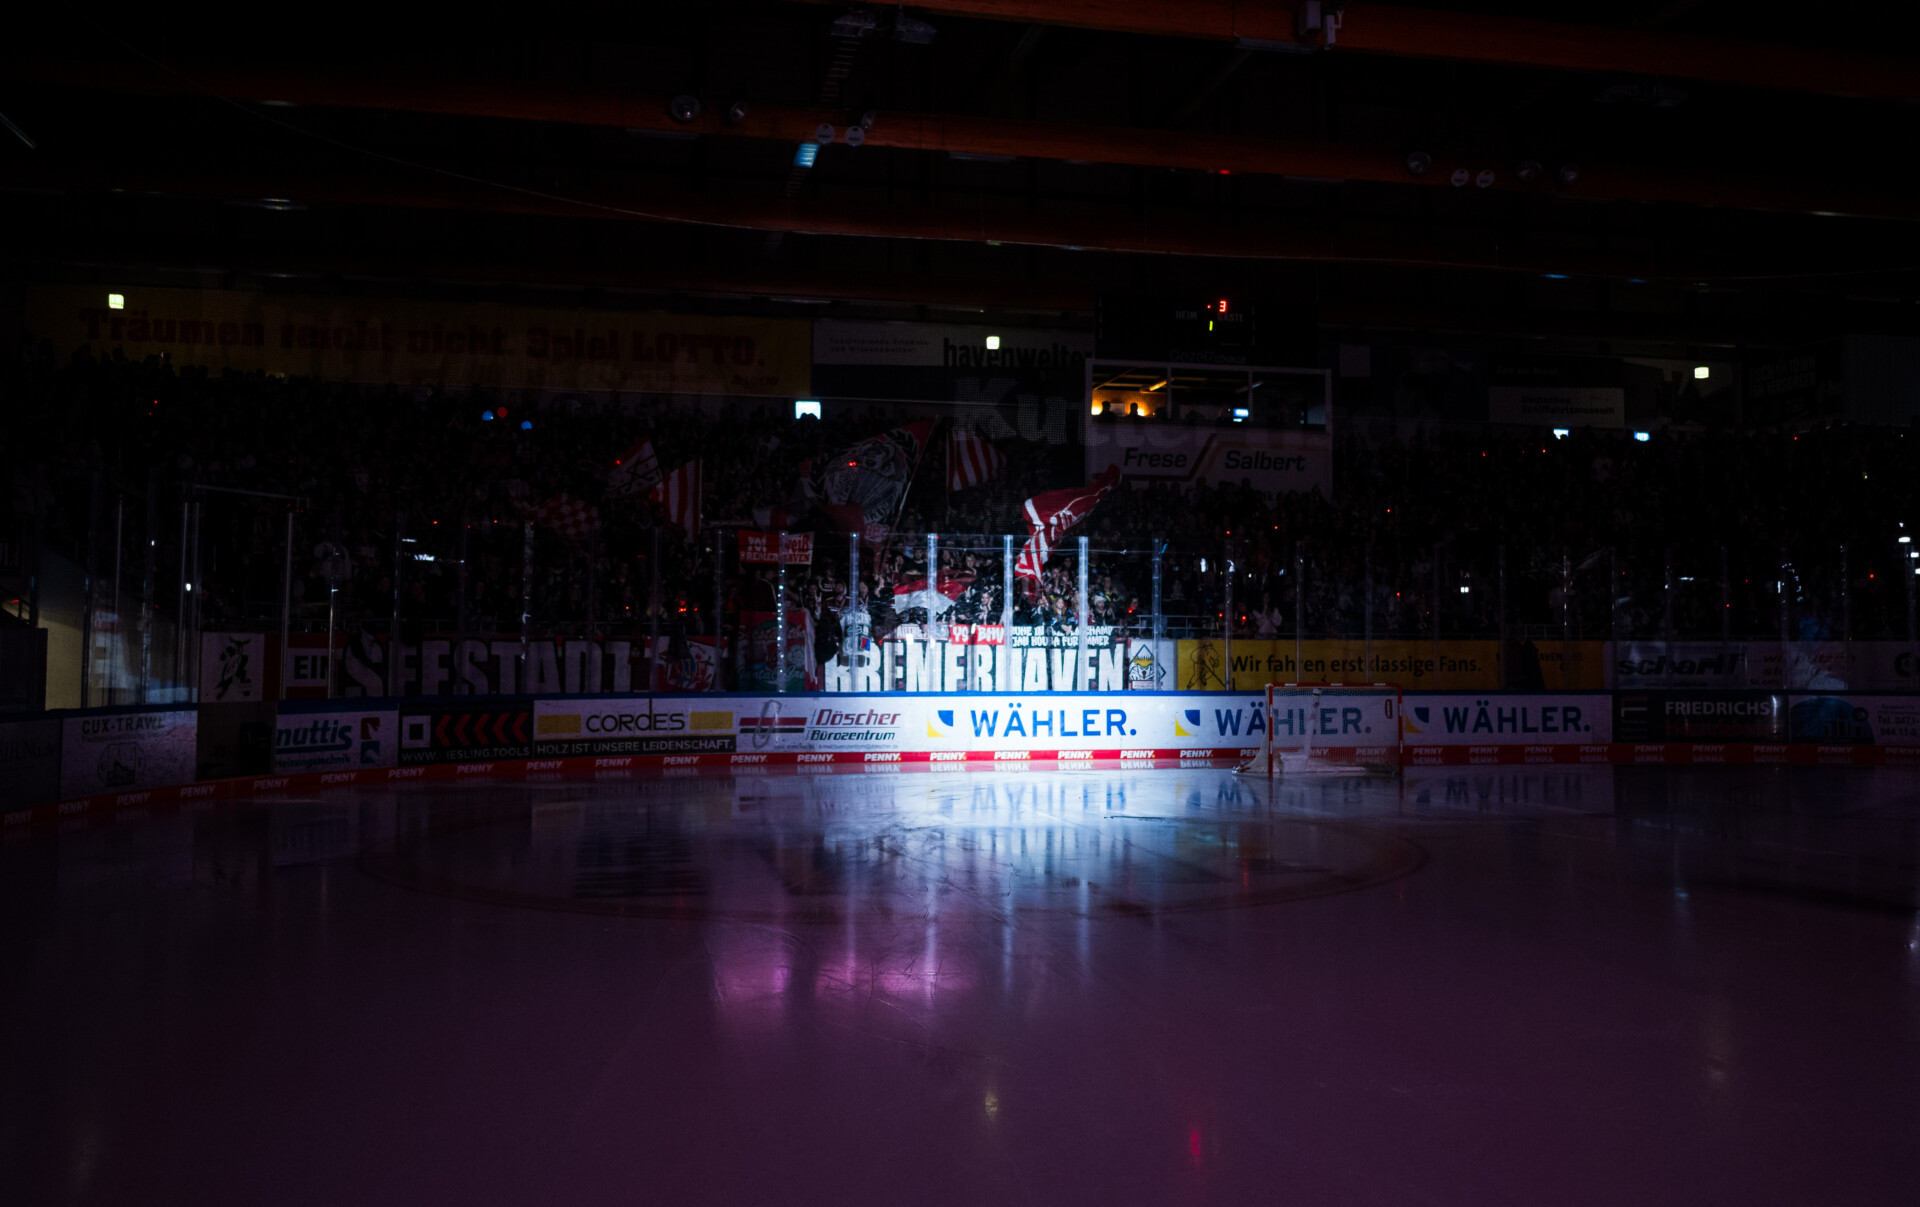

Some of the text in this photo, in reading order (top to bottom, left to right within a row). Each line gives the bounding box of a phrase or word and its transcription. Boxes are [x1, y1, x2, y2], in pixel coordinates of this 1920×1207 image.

[1219, 301, 1227, 312] 3
[79, 308, 265, 347] Träumen
[282, 319, 394, 352] reicht
[527, 327, 620, 366] Spiel
[1124, 447, 1306, 473] Frese Salbert
[739, 551, 810, 562] BREMERAVEN
[825, 640, 1125, 692] BREMERHAVEN
[1230, 656, 1262, 672] Wir
[1267, 655, 1325, 672] fahen
[1331, 656, 1434, 677] erstlassige
[1438, 656, 1483, 672] Fans.
[816, 708, 902, 726] Döscher
[1443, 700, 1591, 733] WÄHLER.
[1664, 701, 1771, 715] FRIEDRICHS
[970, 702, 1138, 737] WÄHLER.
[1215, 701, 1372, 736] WÄHLER.
[276, 719, 353, 748] nuttis
[810, 729, 896, 741] Bürozentrum
[537, 738, 734, 755] HOLZ IST UNSERE LEIDENSCHAFT.
[1240, 749, 1258, 758] PEN
[274, 754, 352, 769] Heizungstechnik
